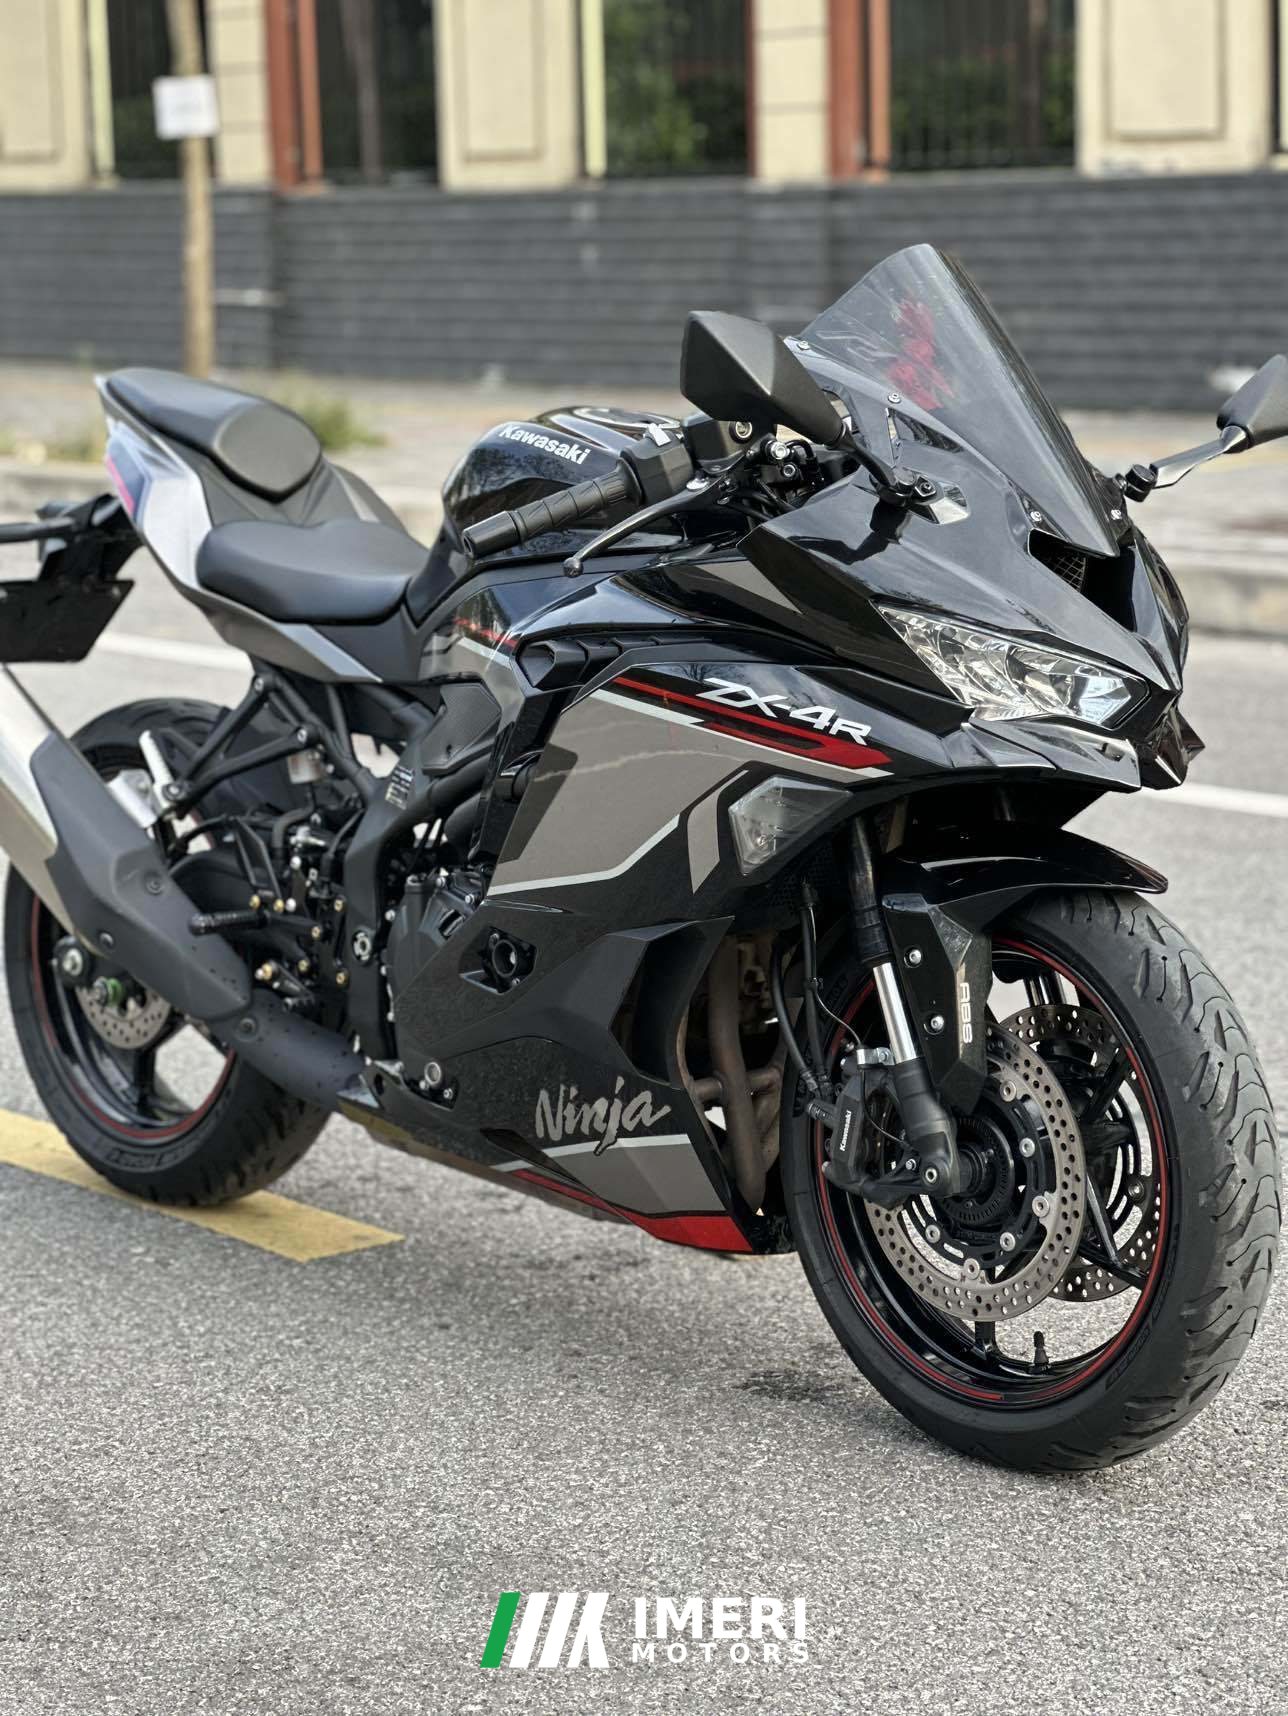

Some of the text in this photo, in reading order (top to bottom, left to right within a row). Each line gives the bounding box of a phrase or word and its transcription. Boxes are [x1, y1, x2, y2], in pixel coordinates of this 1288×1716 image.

[499, 424, 591, 465] Kawasaki
[696, 677, 872, 746] ZX-4R
[960, 982, 973, 1044] ABS
[535, 1076, 672, 1156] Ninja
[840, 1109, 852, 1152] Kawasaki
